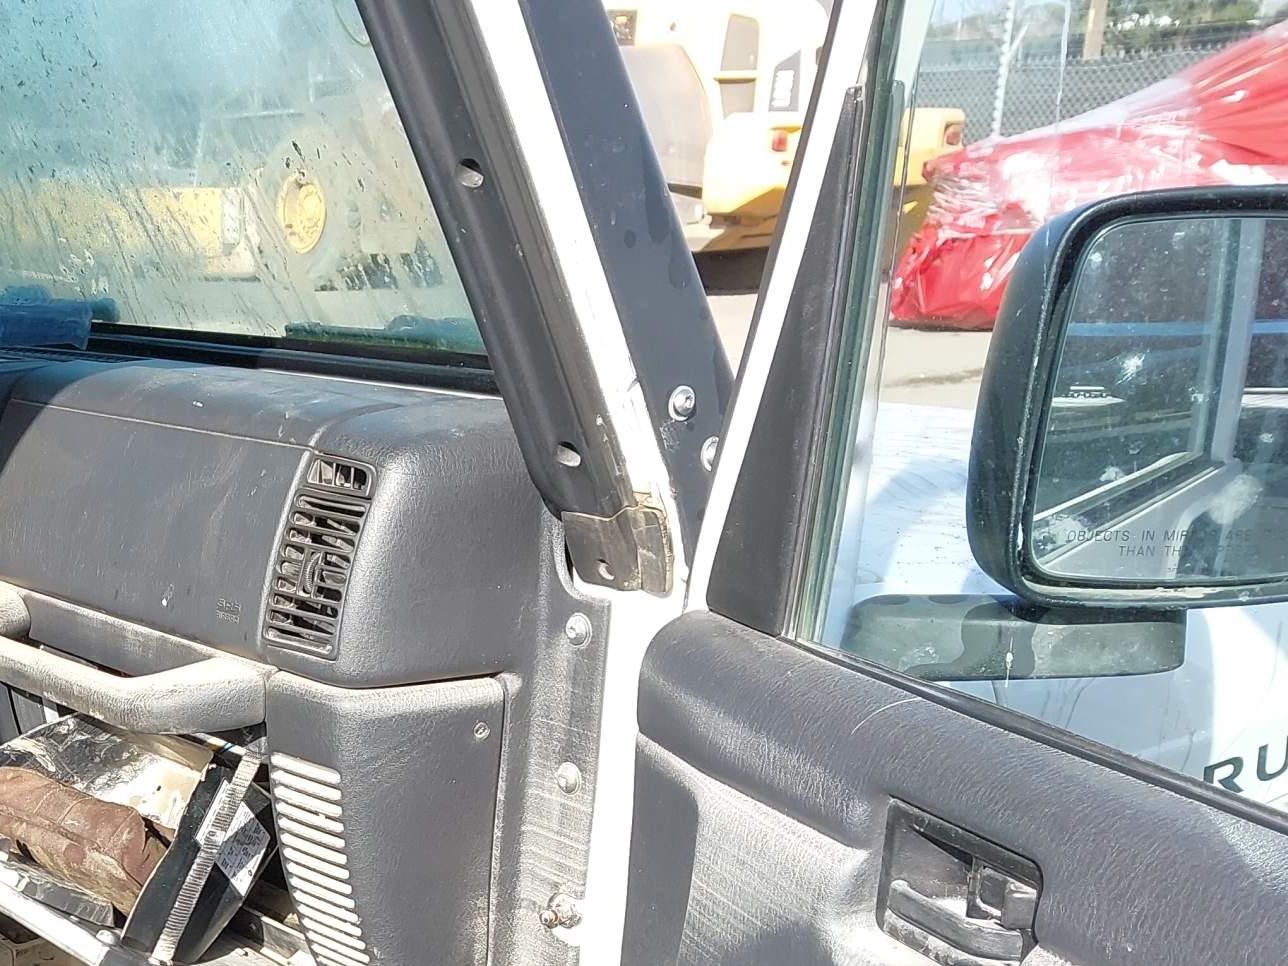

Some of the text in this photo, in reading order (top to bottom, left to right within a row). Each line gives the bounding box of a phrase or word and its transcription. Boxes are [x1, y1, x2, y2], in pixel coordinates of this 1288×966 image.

[1067, 529, 1130, 542] OBJECTS
[1141, 529, 1155, 542] IN
[1119, 545, 1156, 557] THAN
